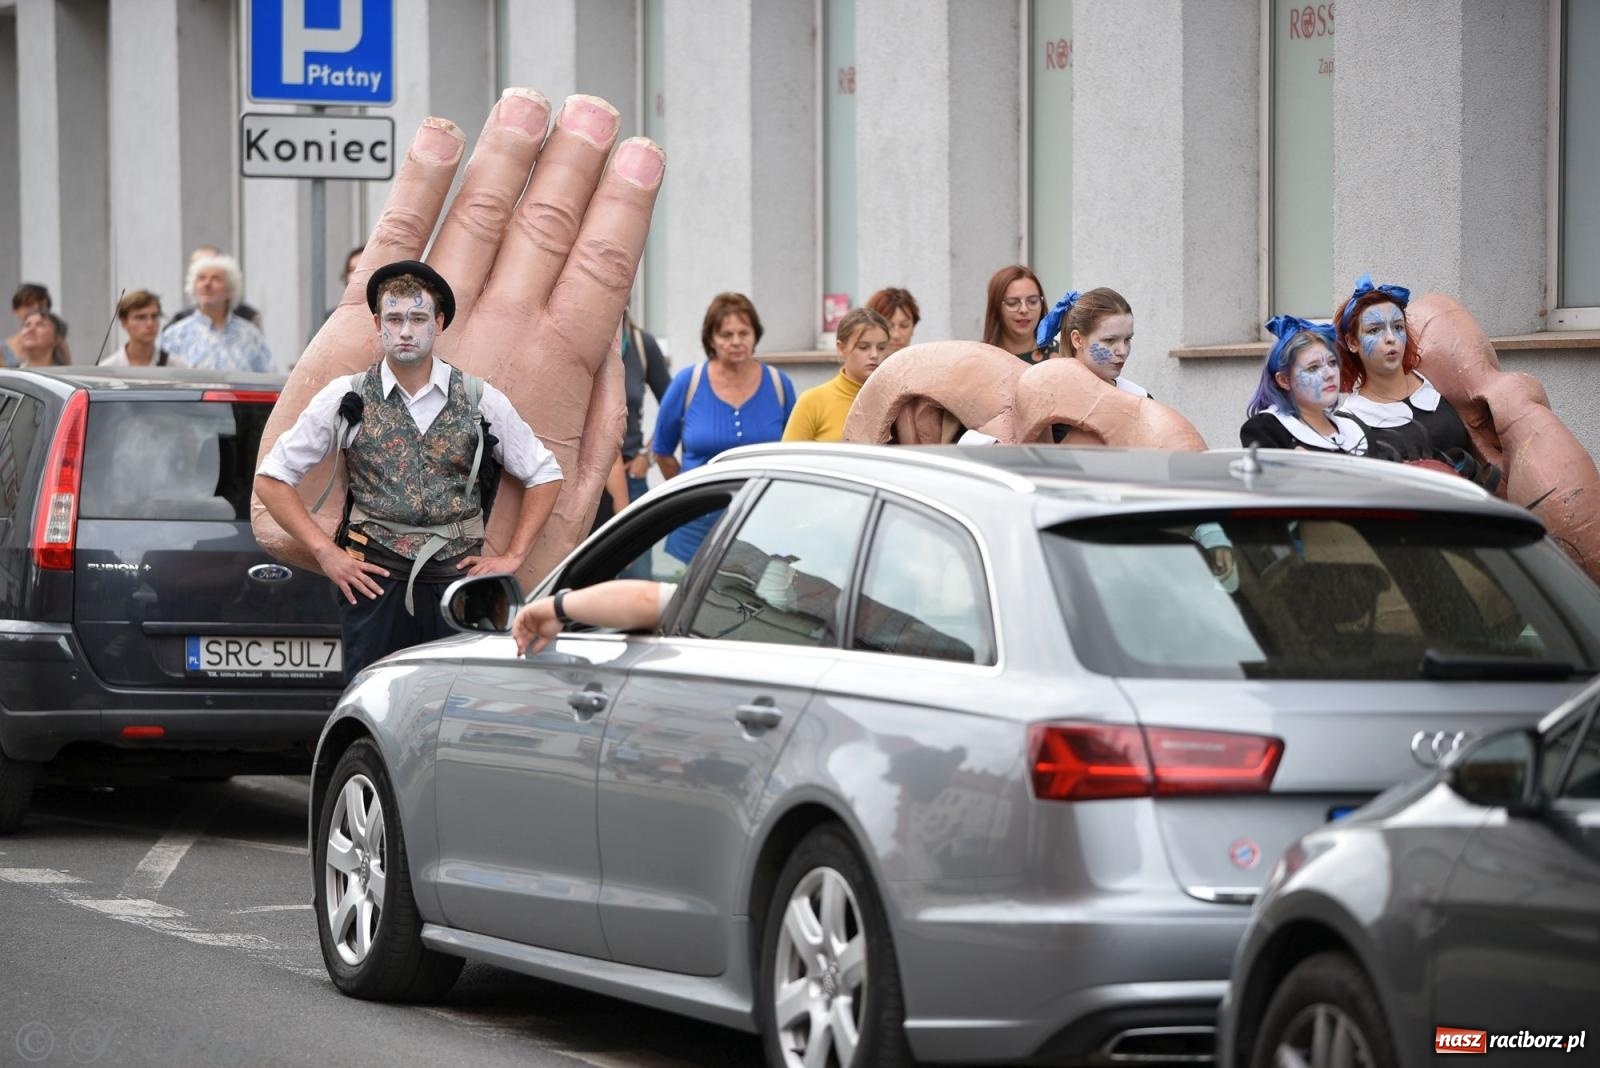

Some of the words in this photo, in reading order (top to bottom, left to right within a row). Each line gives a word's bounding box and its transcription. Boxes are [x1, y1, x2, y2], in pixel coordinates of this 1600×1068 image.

[282, 0, 363, 85] P
[307, 64, 382, 93] Płatny
[246, 128, 387, 163] Koniec
[189, 656, 199, 664] PL
[206, 640, 262, 666] SRC
[273, 641, 337, 668] 5UL7
